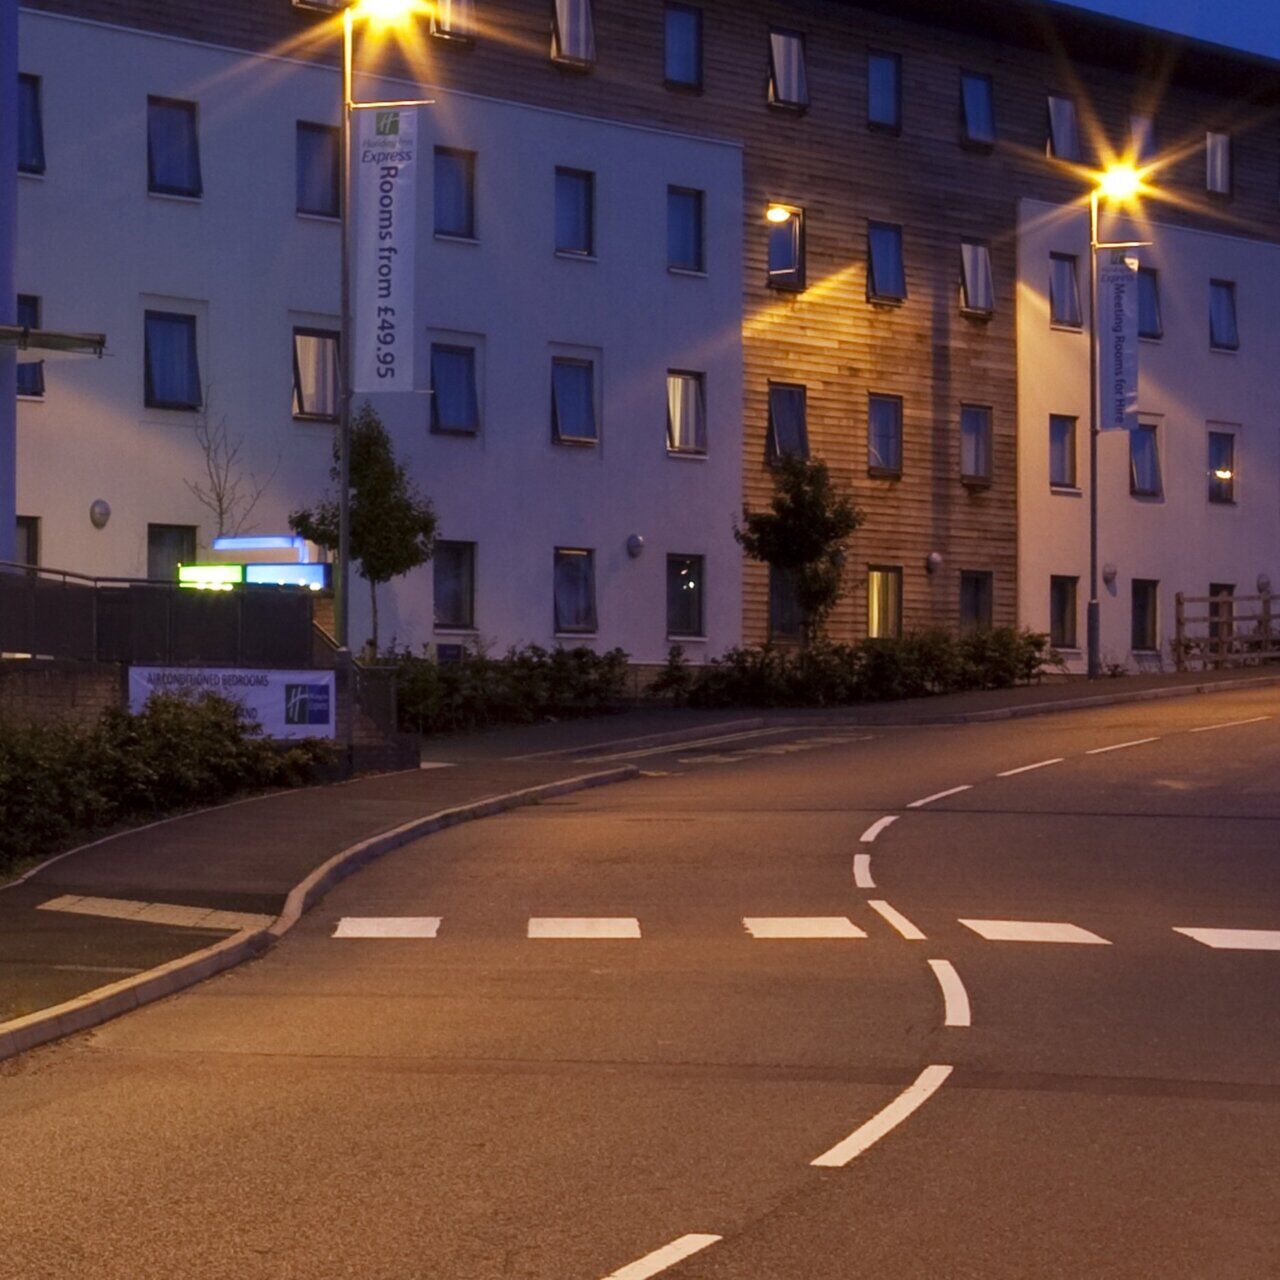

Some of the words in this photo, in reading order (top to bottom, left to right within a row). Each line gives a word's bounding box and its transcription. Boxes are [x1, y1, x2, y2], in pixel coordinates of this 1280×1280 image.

[361, 150, 413, 165] Express
[378, 165, 398, 241] Rooms
[377, 246, 398, 299] from
[1111, 283, 1126, 333] Meeting
[376, 305, 395, 379] £49.95
[1113, 335, 1126, 376] Rooms
[1114, 378, 1127, 395] for
[1114, 398, 1126, 424] Hire
[221, 674, 269, 687] BEDROOMS
